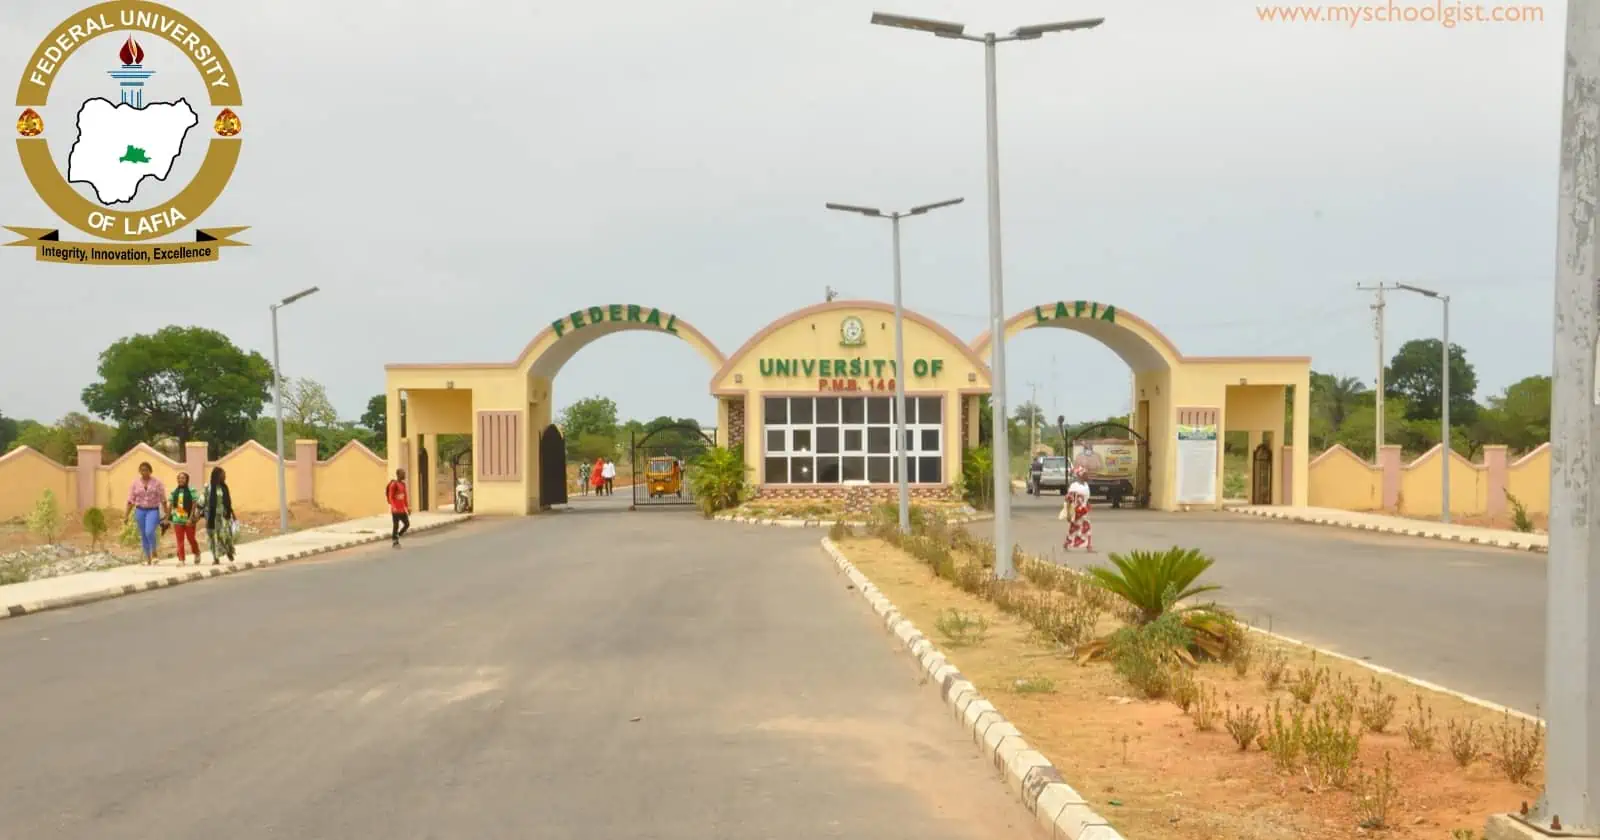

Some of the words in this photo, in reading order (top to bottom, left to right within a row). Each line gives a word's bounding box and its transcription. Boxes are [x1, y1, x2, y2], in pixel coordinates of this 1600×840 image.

[551, 304, 678, 337] FEDERAL
[1035, 299, 1115, 324] LAFIA
[759, 358, 898, 378] UNIVERSITY
[913, 358, 944, 378] OF
